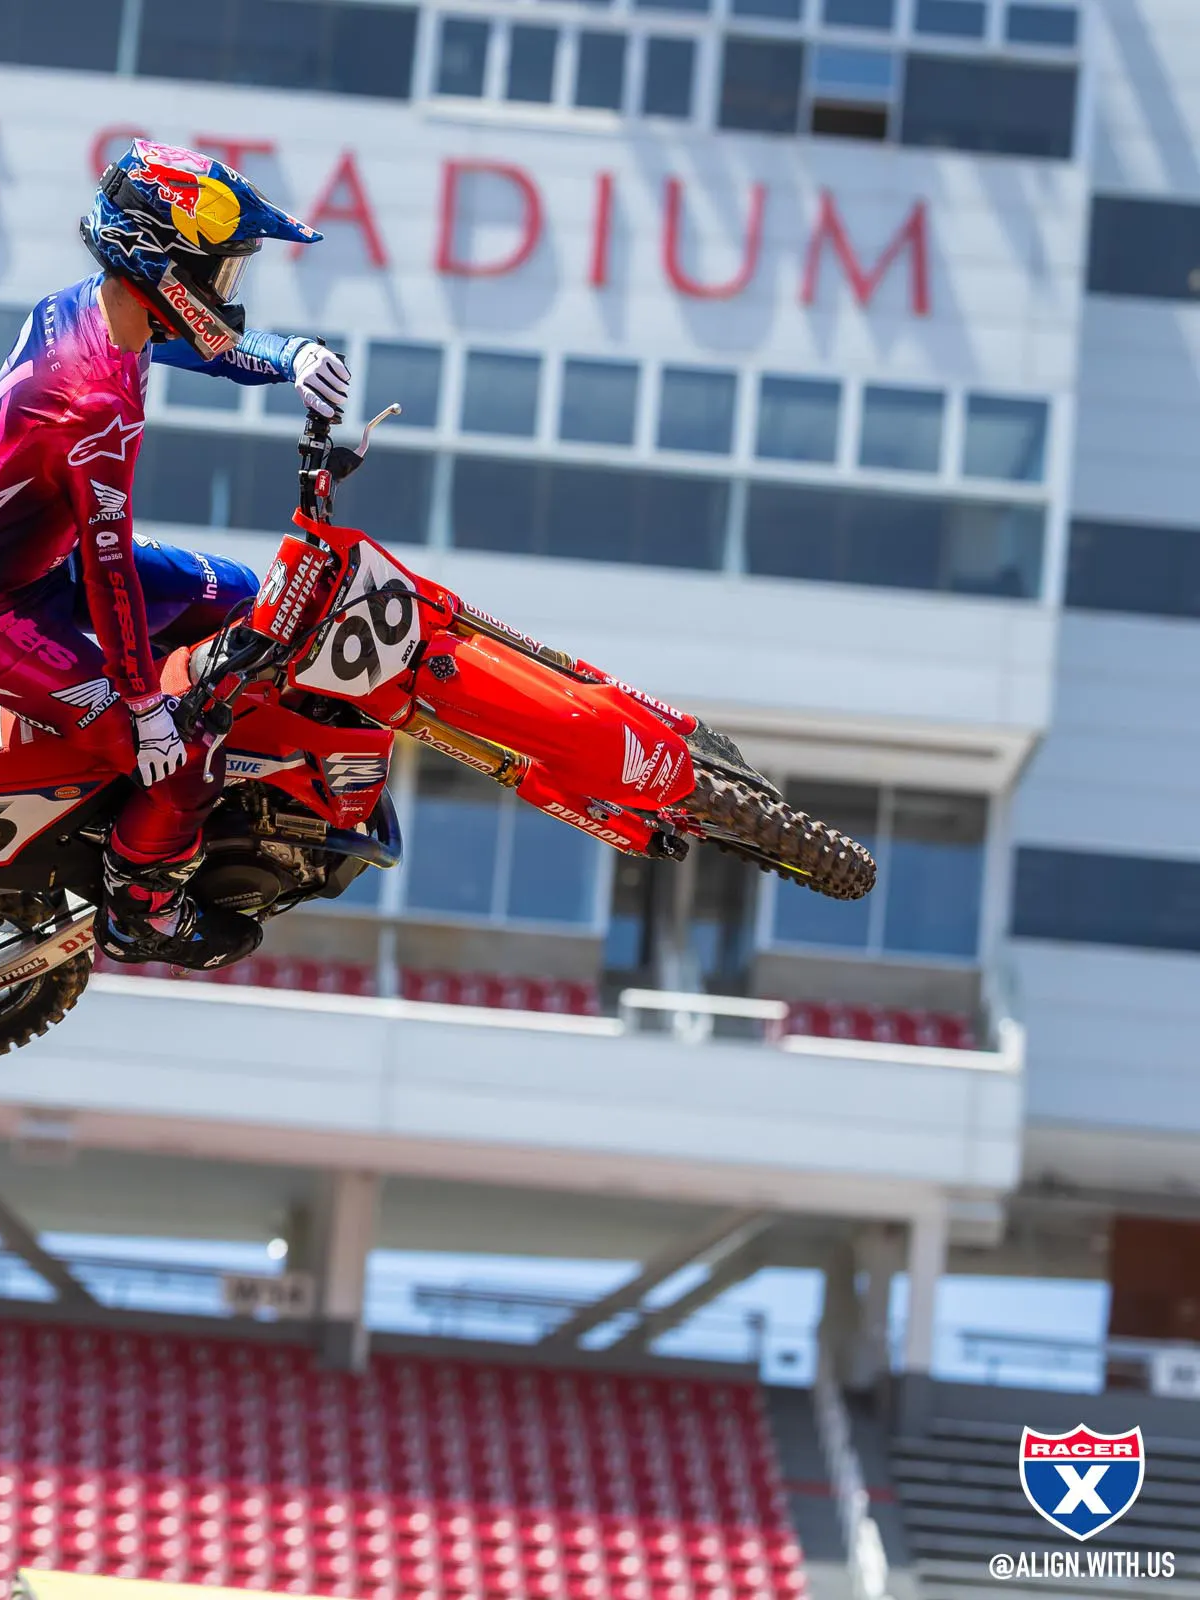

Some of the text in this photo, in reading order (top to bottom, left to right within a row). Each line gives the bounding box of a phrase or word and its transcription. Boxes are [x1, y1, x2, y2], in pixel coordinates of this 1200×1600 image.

[270, 551, 314, 635] RENTHAL
[282, 557, 324, 641] RENTHAL
[331, 562, 414, 695] 96
[77, 690, 121, 729] HONDA
[636, 741, 666, 792] HONDA
[543, 801, 631, 847] DUNLOP
